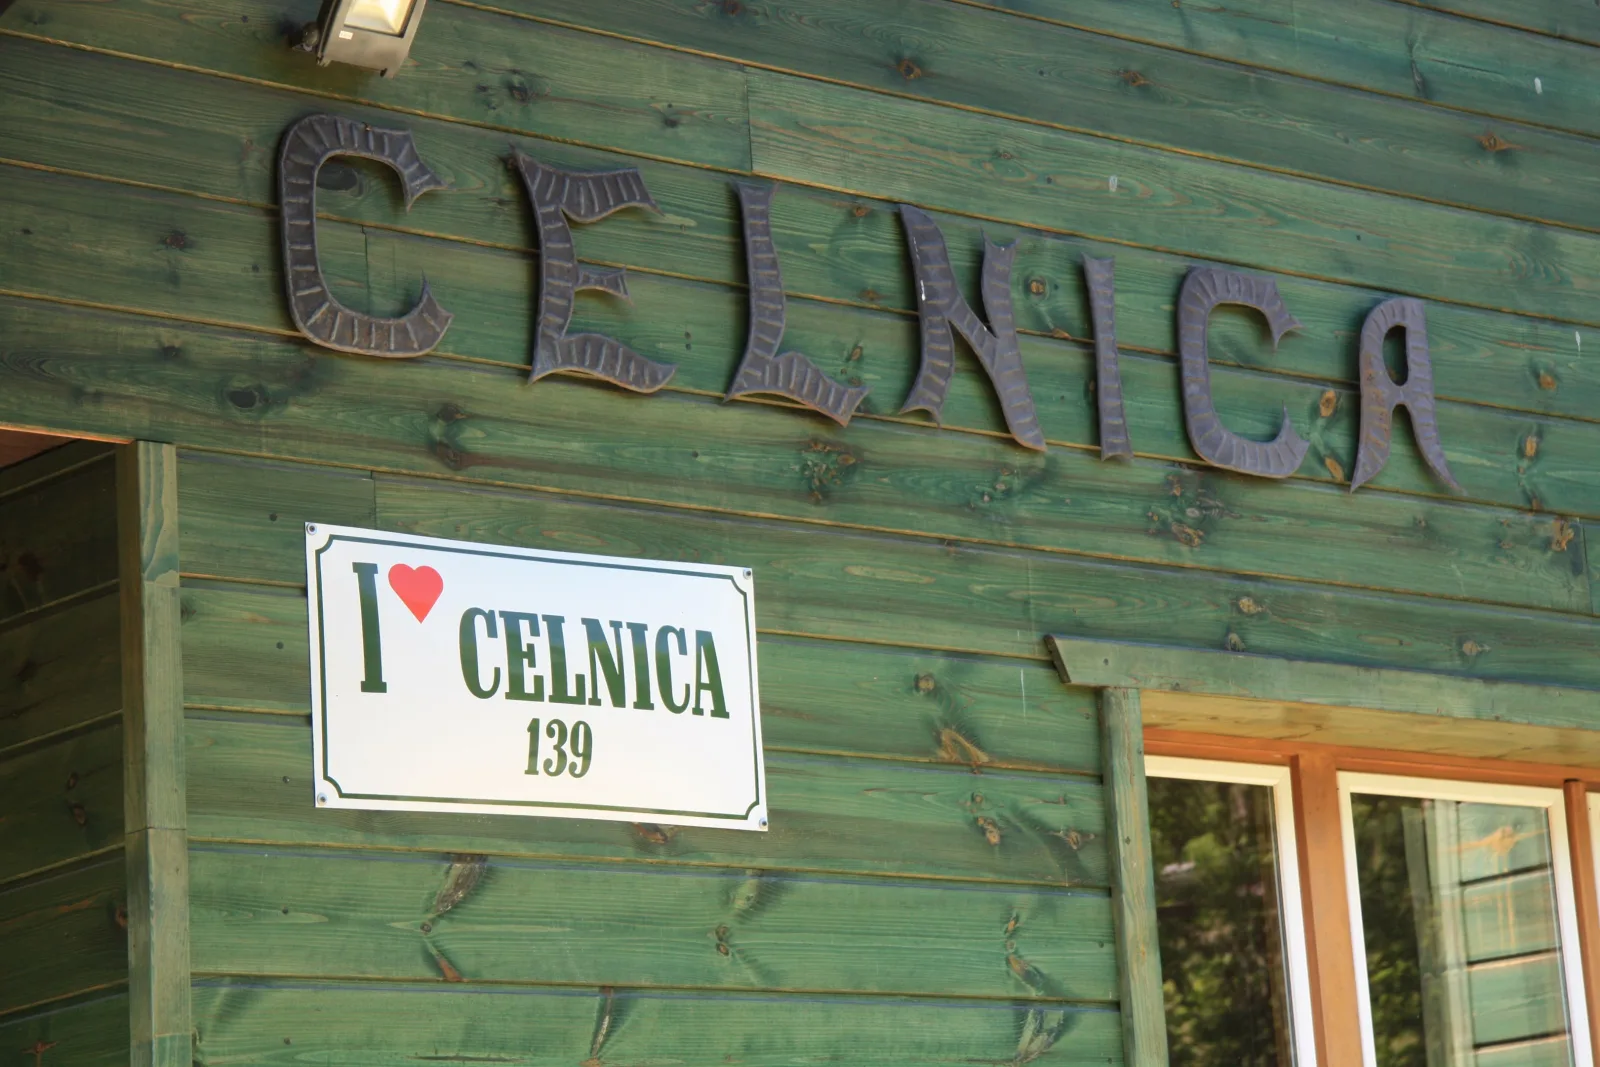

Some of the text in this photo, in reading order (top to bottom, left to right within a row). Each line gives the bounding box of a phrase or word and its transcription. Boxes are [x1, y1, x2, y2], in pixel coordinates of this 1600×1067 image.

[278, 113, 1467, 495] CELNICA
[352, 561, 730, 719] I CELNICA
[524, 718, 593, 779] 139
